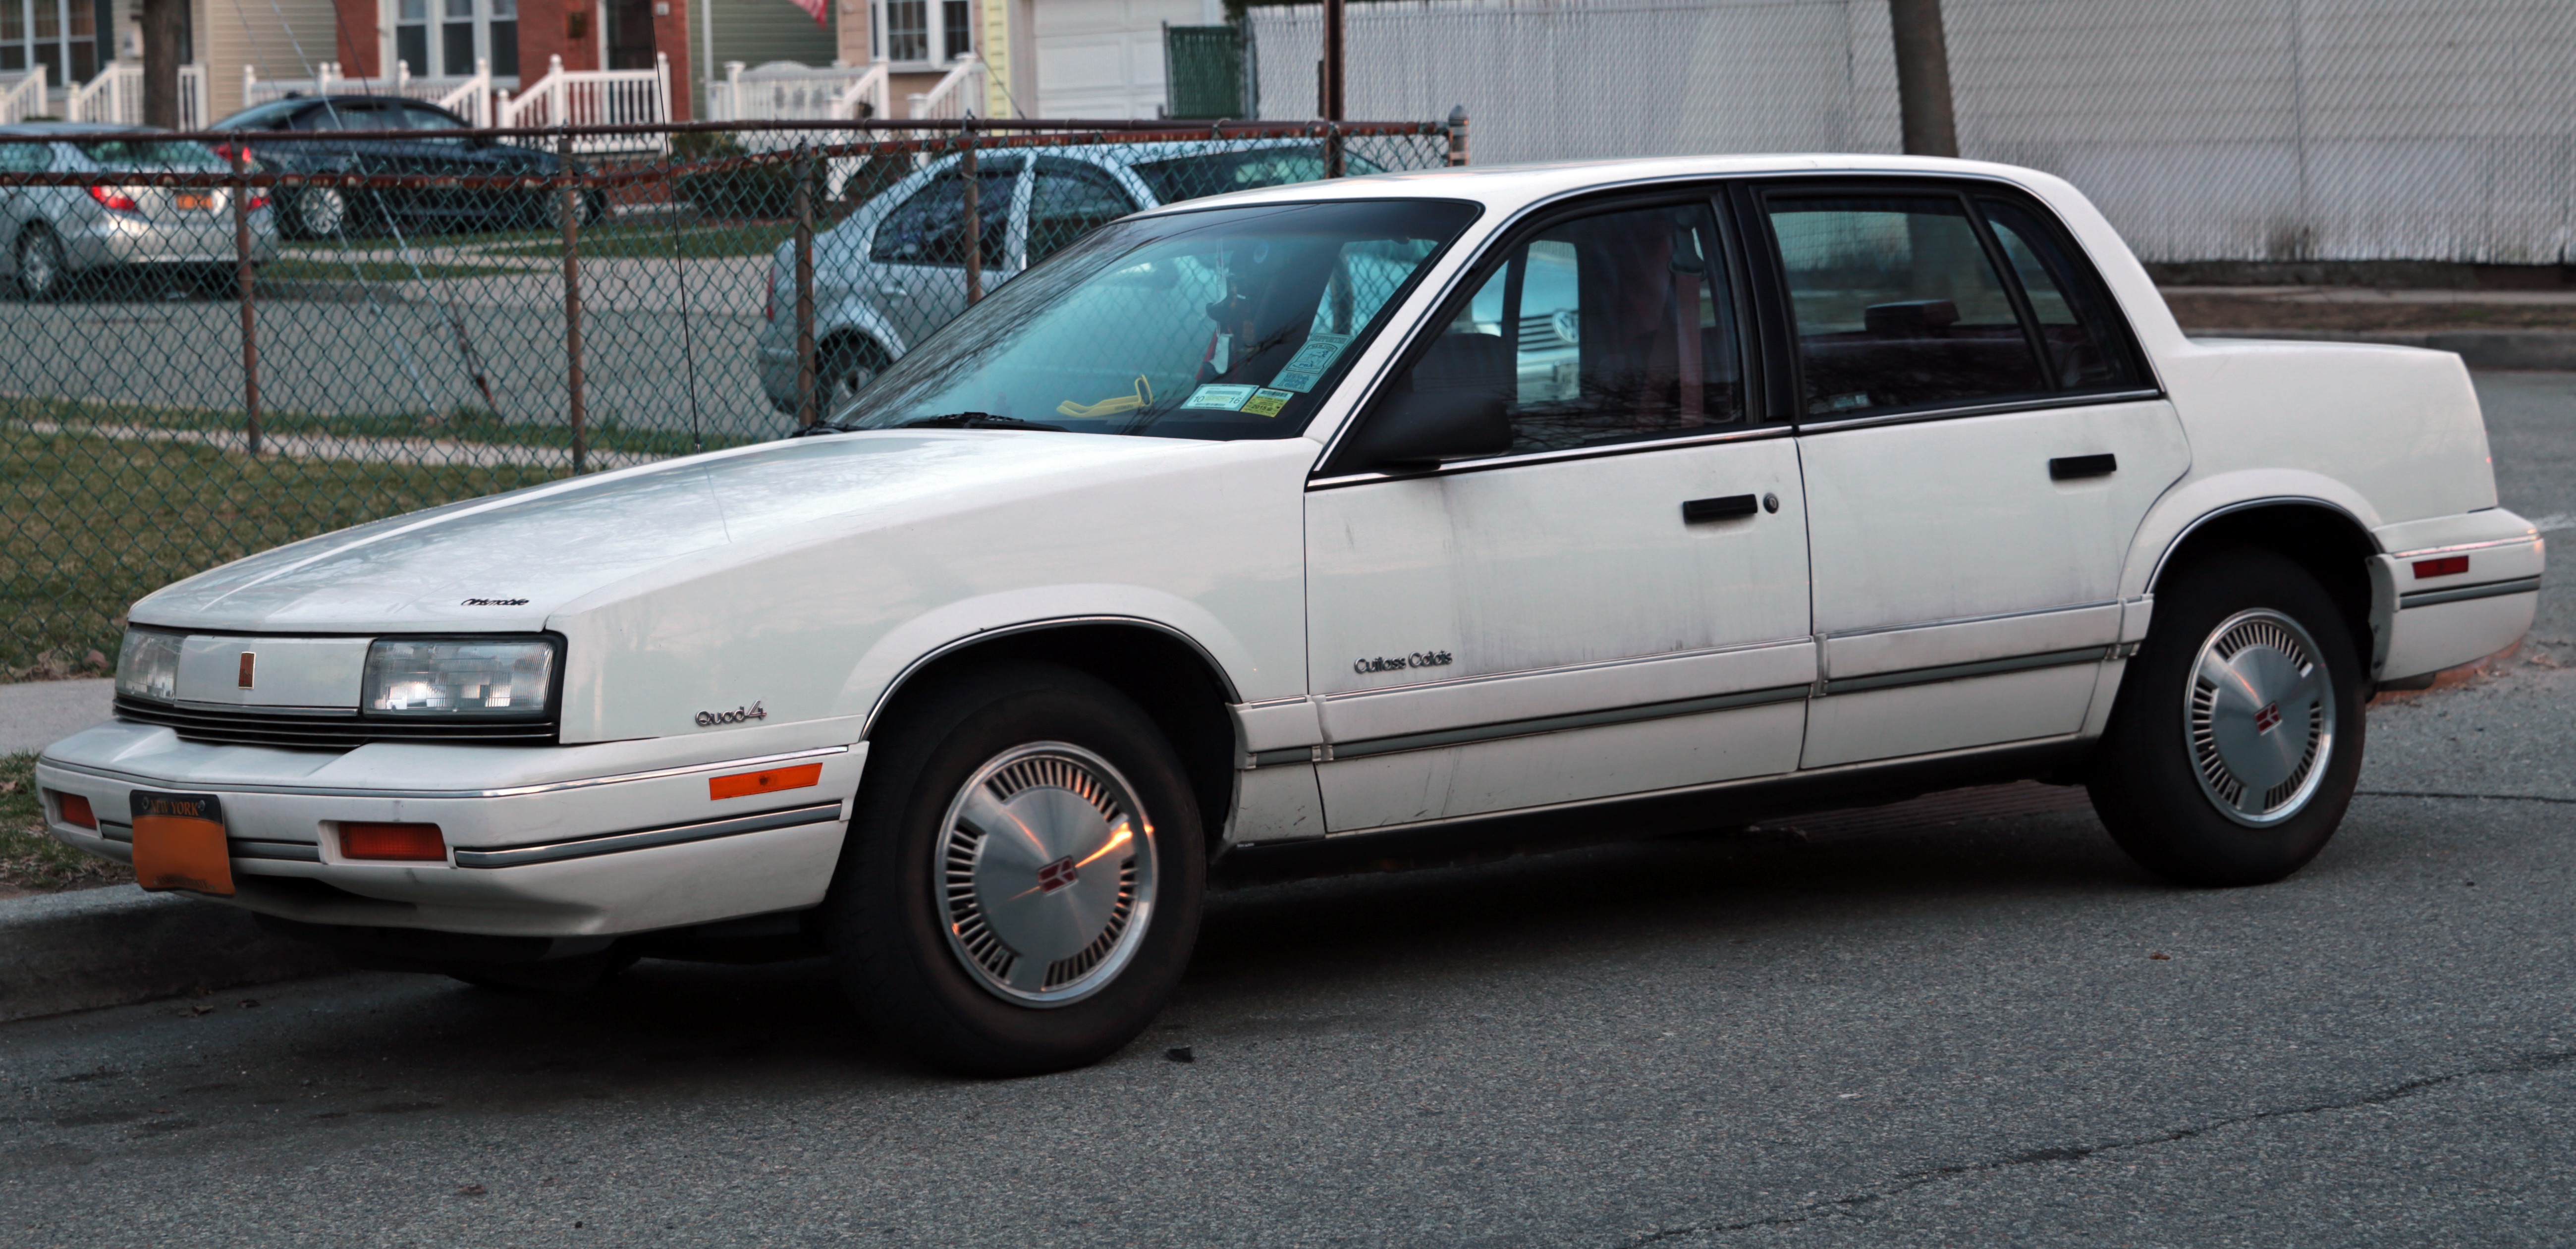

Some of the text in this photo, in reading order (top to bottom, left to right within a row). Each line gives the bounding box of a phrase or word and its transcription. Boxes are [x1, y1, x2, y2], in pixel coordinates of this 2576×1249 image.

[1354, 650, 1453, 674] Cutlass Calais
[150, 799, 199, 816] NEW YORK
